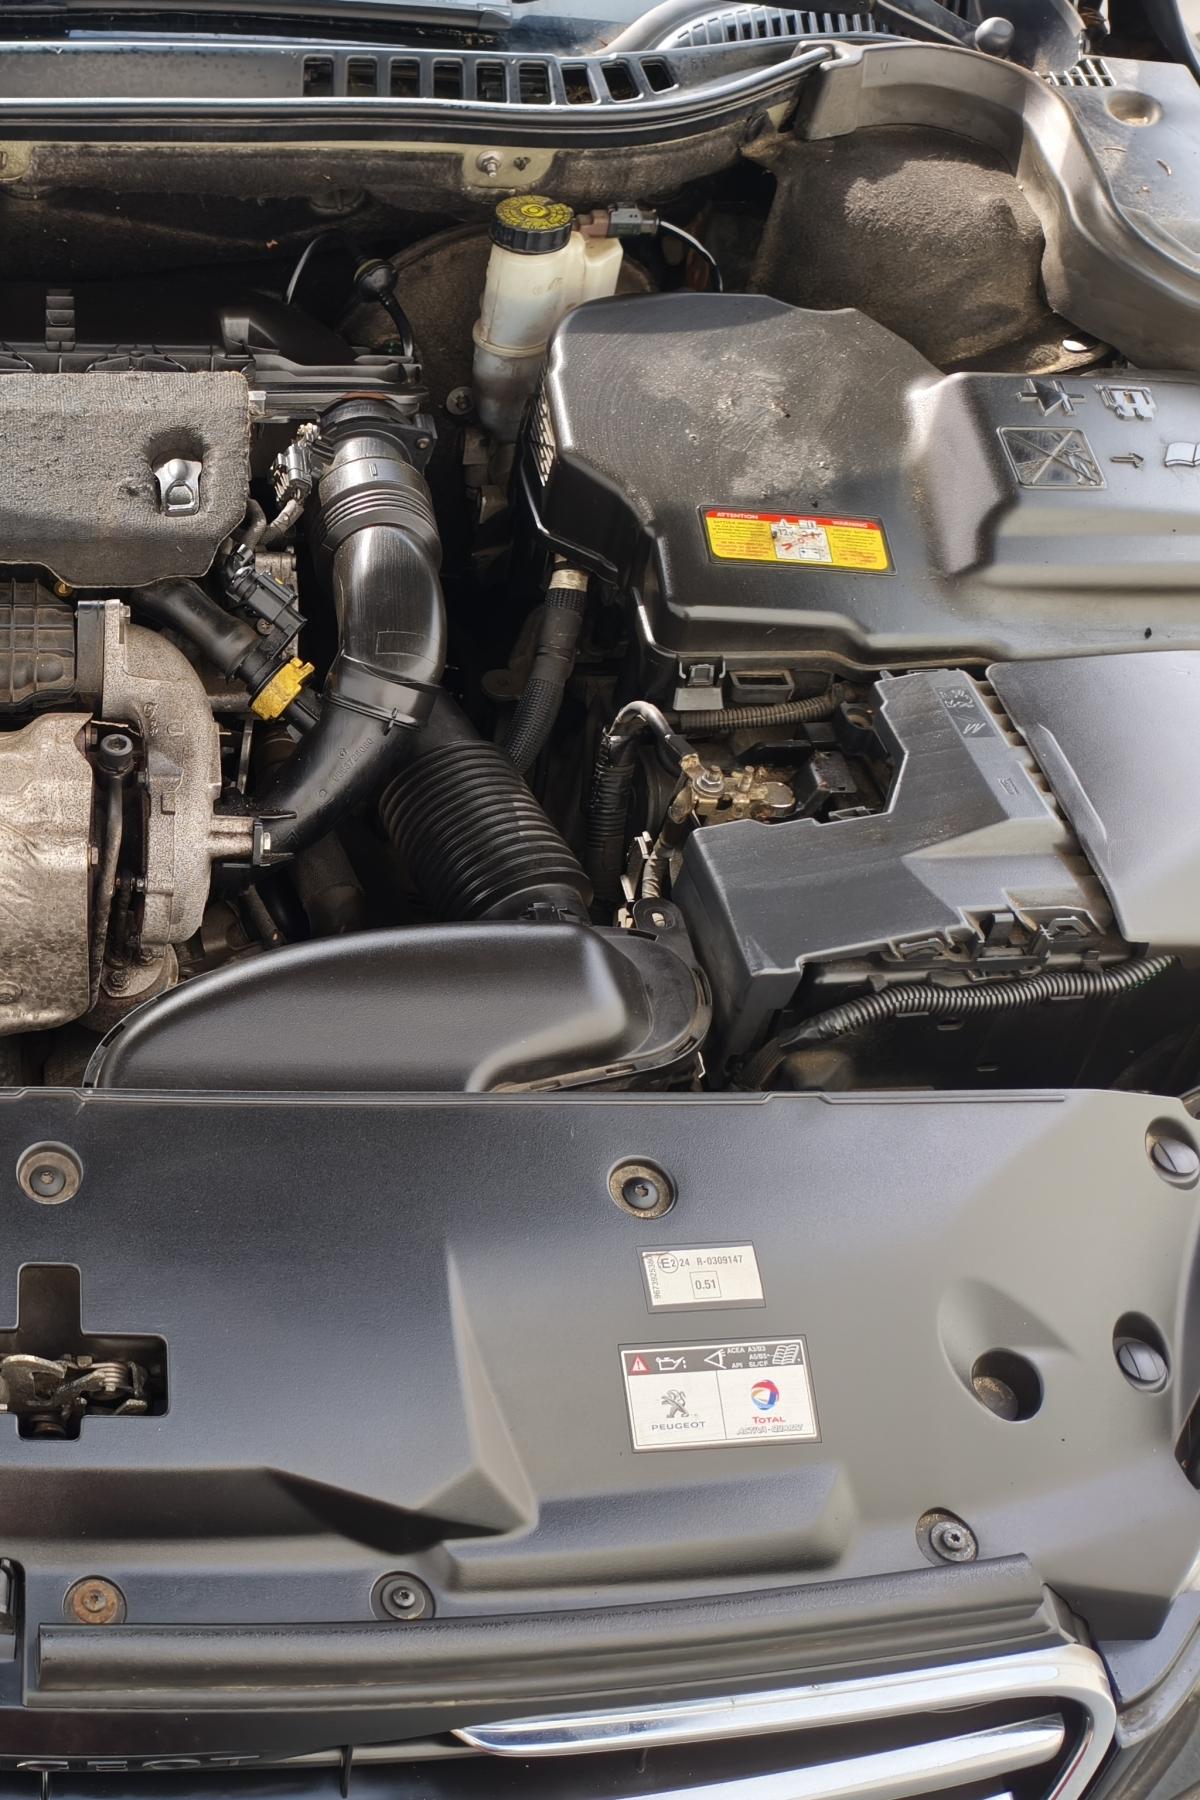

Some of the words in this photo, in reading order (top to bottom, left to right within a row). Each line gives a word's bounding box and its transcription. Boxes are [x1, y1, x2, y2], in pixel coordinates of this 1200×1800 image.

[716, 512, 759, 520] ATTENTION
[680, 1258, 690, 1267] 24
[695, 1279, 717, 1290] 0.51
[651, 1421, 707, 1430] PEUGEOT
